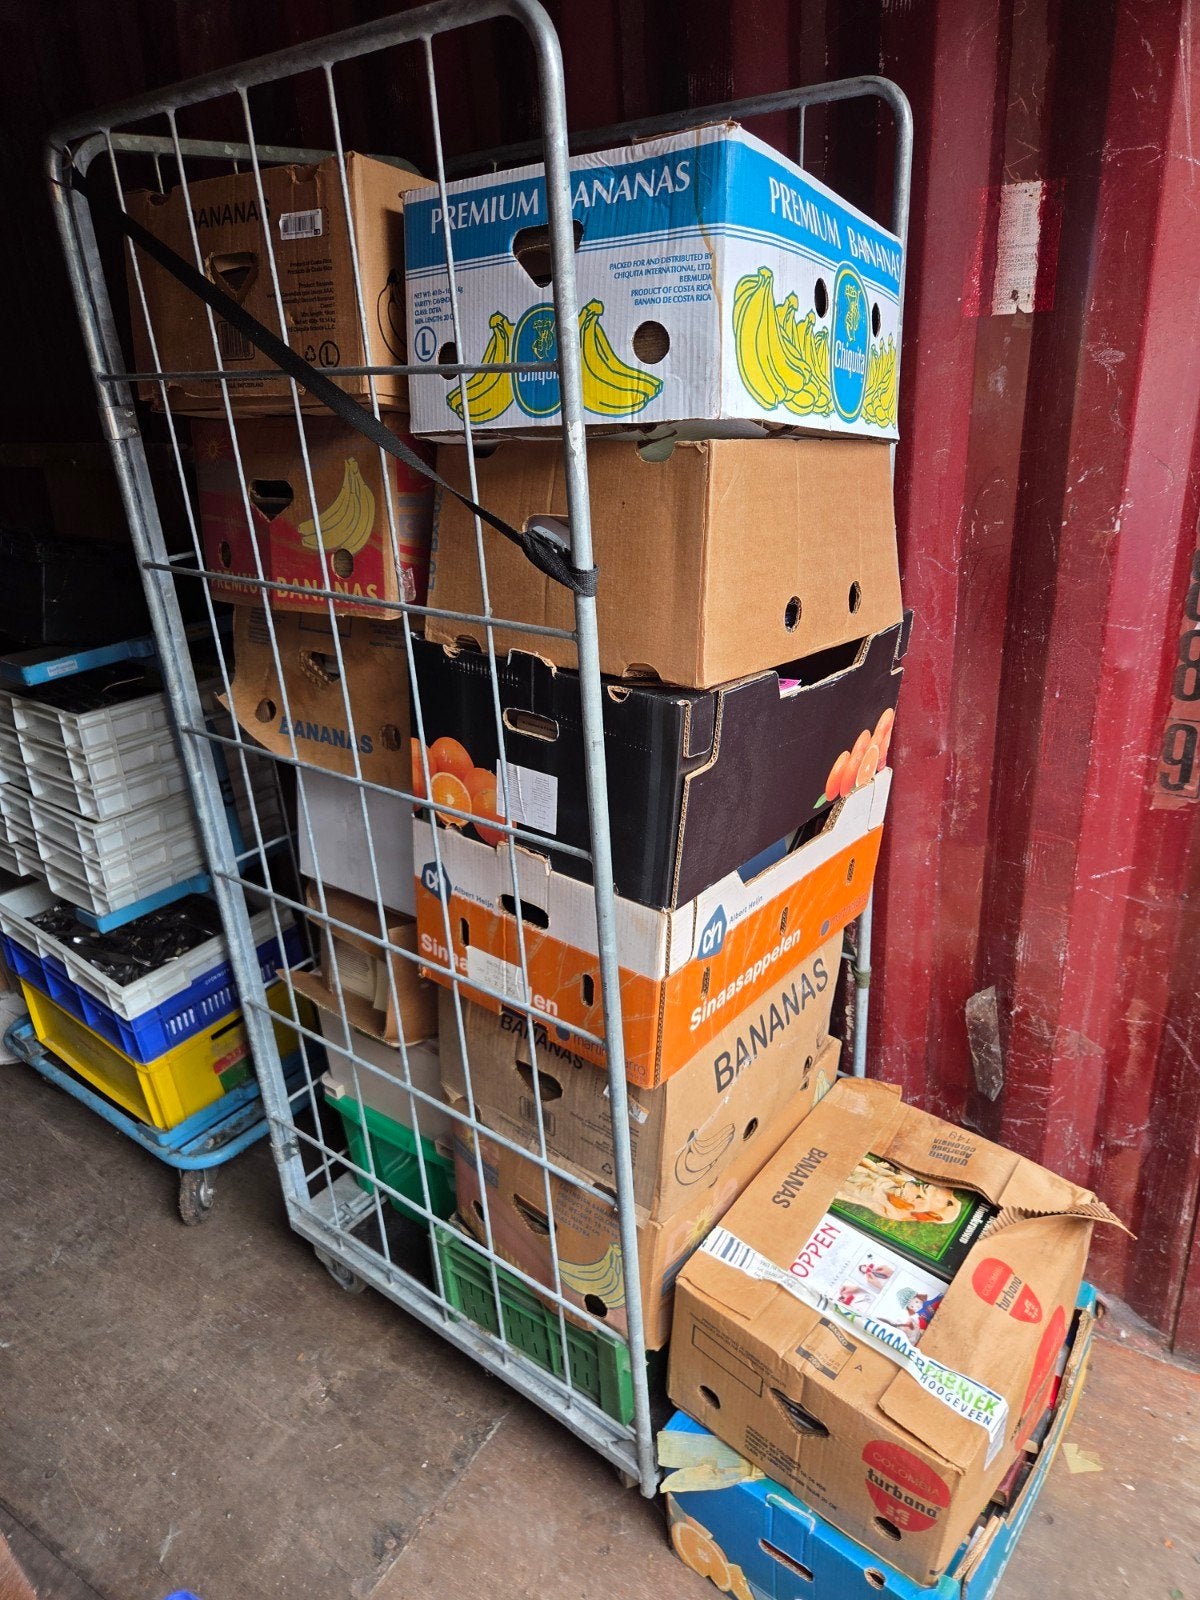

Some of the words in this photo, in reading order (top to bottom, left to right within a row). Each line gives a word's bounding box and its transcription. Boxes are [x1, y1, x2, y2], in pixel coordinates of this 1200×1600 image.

[431, 189, 540, 234] PREMIUM
[571, 161, 692, 210] ANANAS
[769, 176, 842, 250] PREMIUM
[609, 260, 632, 270] PACKED
[632, 259, 646, 268] FOR
[646, 257, 660, 266] AND
[661, 253, 704, 265] DISTRIBUTED
[704, 252, 714, 261] BY
[613, 268, 644, 280] CHIQUITA
[644, 265, 697, 276] INTERNATIONAL,
[697, 263, 713, 271] LTD.
[680, 273, 713, 283] BERMUDA
[630, 286, 662, 297] PRODUCT
[662, 286, 673, 294] OF
[673, 284, 696, 293] COSTA
[696, 283, 713, 292] RICA
[634, 296, 662, 306] BANANO
[662, 295, 672, 304] DE
[672, 294, 696, 303] COSTA
[696, 293, 713, 302] RICA
[835, 339, 866, 379] Chiquita
[454, 885, 475, 899] Albert
[729, 904, 748, 924] Albert
[748, 895, 763, 911] Heijn
[689, 928, 801, 1032] Sinaasappelen
[714, 957, 828, 1094] BANANAS
[772, 1147, 829, 1209] BANANAS
[995, 1276, 1023, 1312] turbana
[919, 1374, 994, 1427] HOOGEVEEN
[867, 1467, 937, 1519] turbana
[873, 1451, 940, 1497] COLOMBIA
